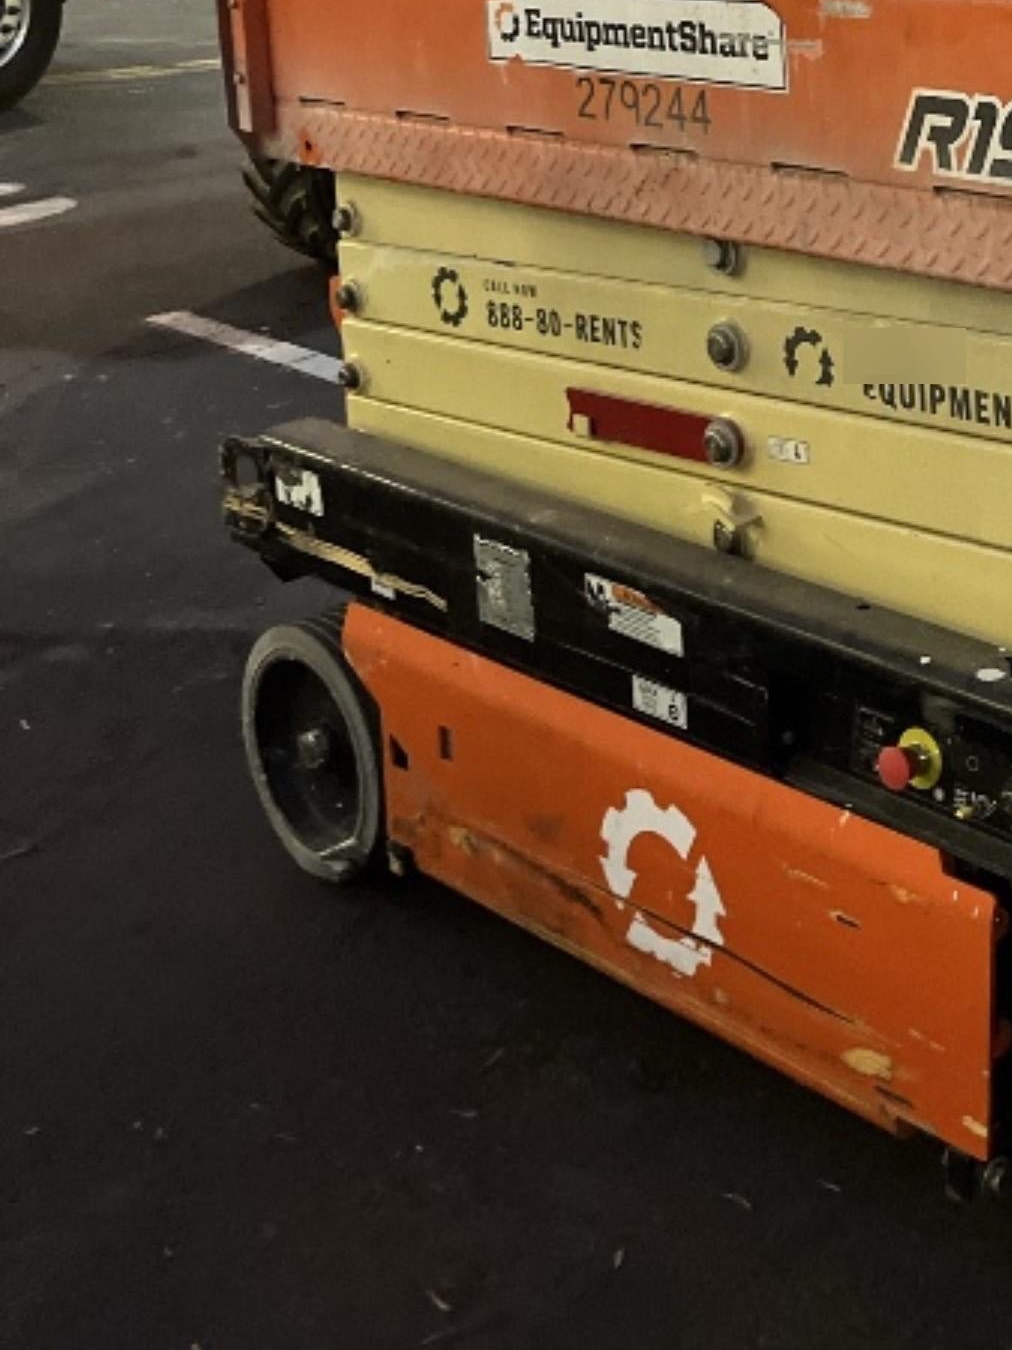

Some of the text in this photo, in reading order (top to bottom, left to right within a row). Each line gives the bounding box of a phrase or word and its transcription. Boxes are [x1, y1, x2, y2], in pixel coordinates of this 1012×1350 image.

[524, 7, 770, 60] EquipmentShare
[576, 76, 712, 135] 279244
[486, 300, 643, 350] 888-80-RENTS
